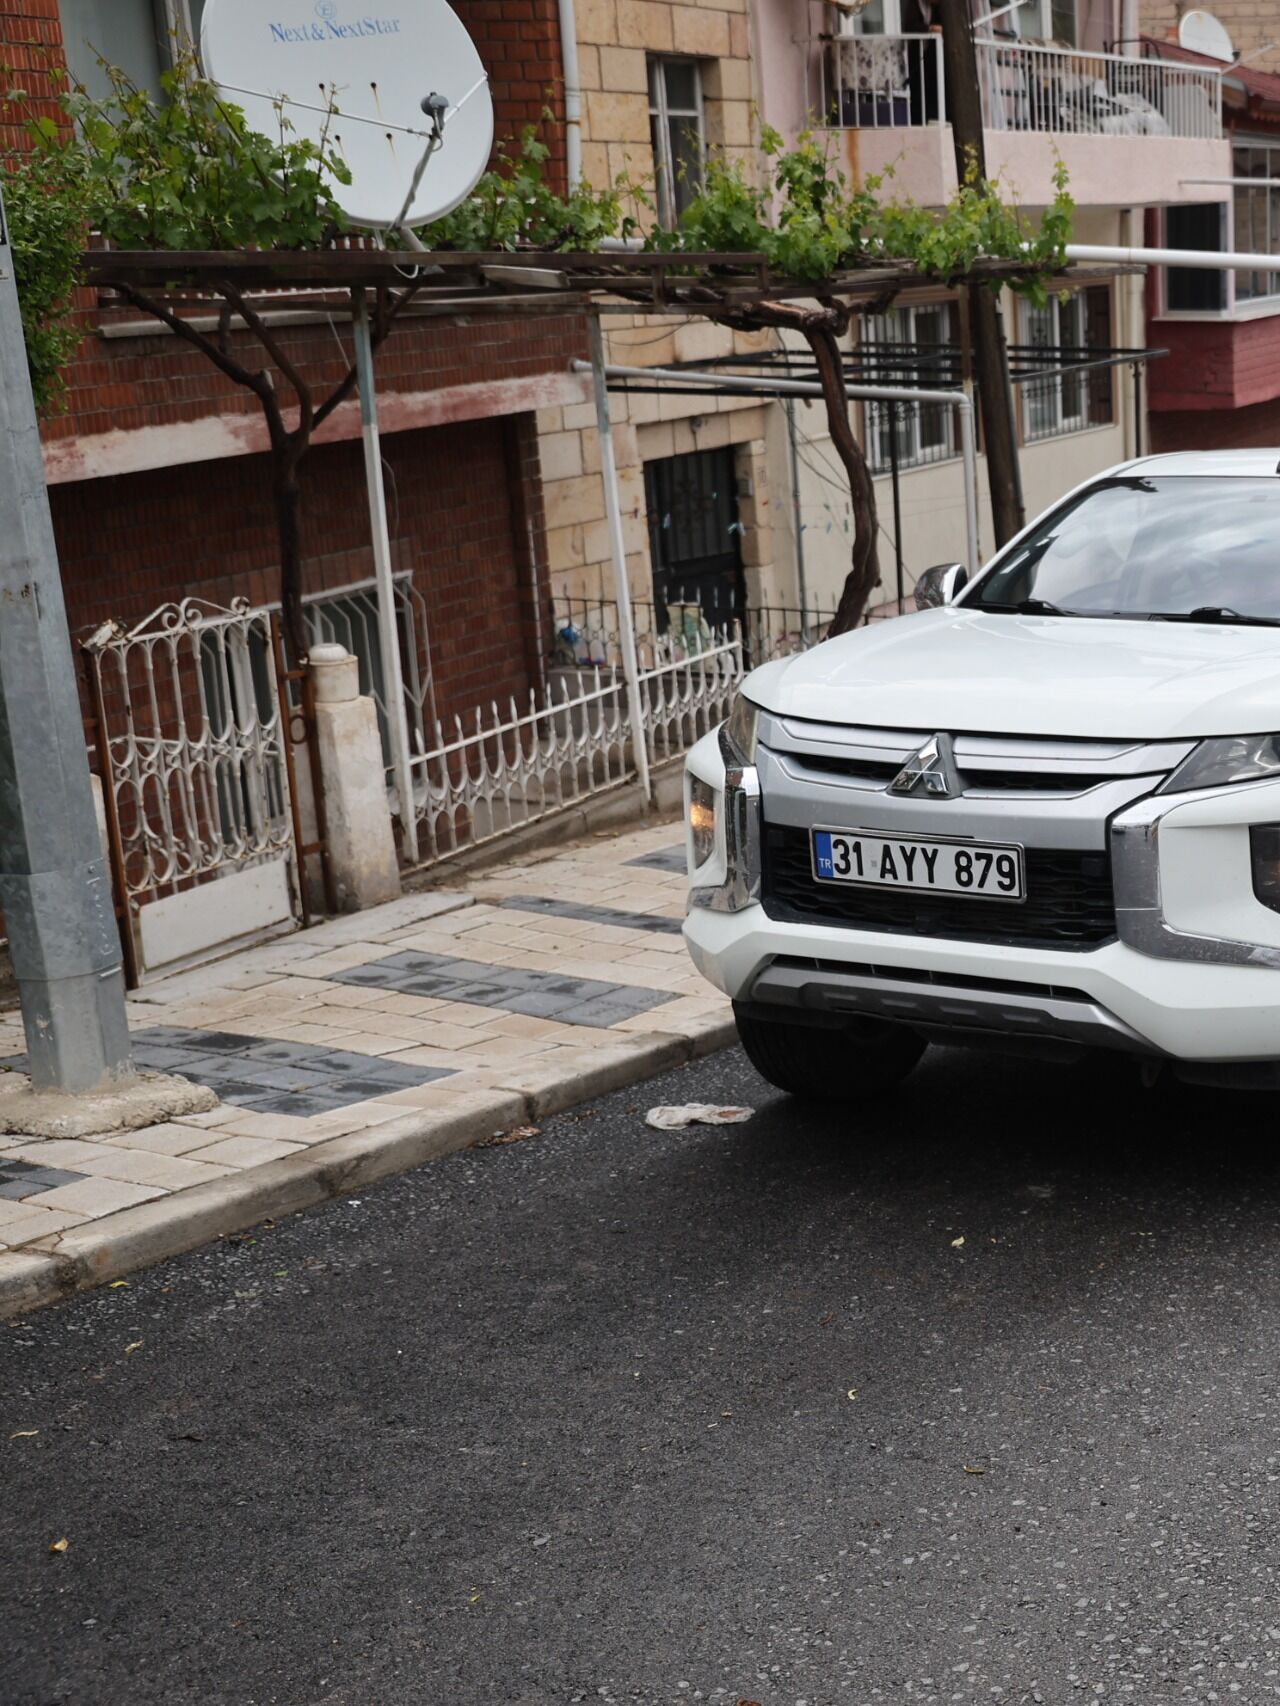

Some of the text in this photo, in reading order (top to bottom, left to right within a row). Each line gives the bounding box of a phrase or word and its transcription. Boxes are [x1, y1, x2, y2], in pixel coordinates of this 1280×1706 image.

[819, 857, 831, 869] TR
[832, 839, 1017, 892] 31 AYY 879
